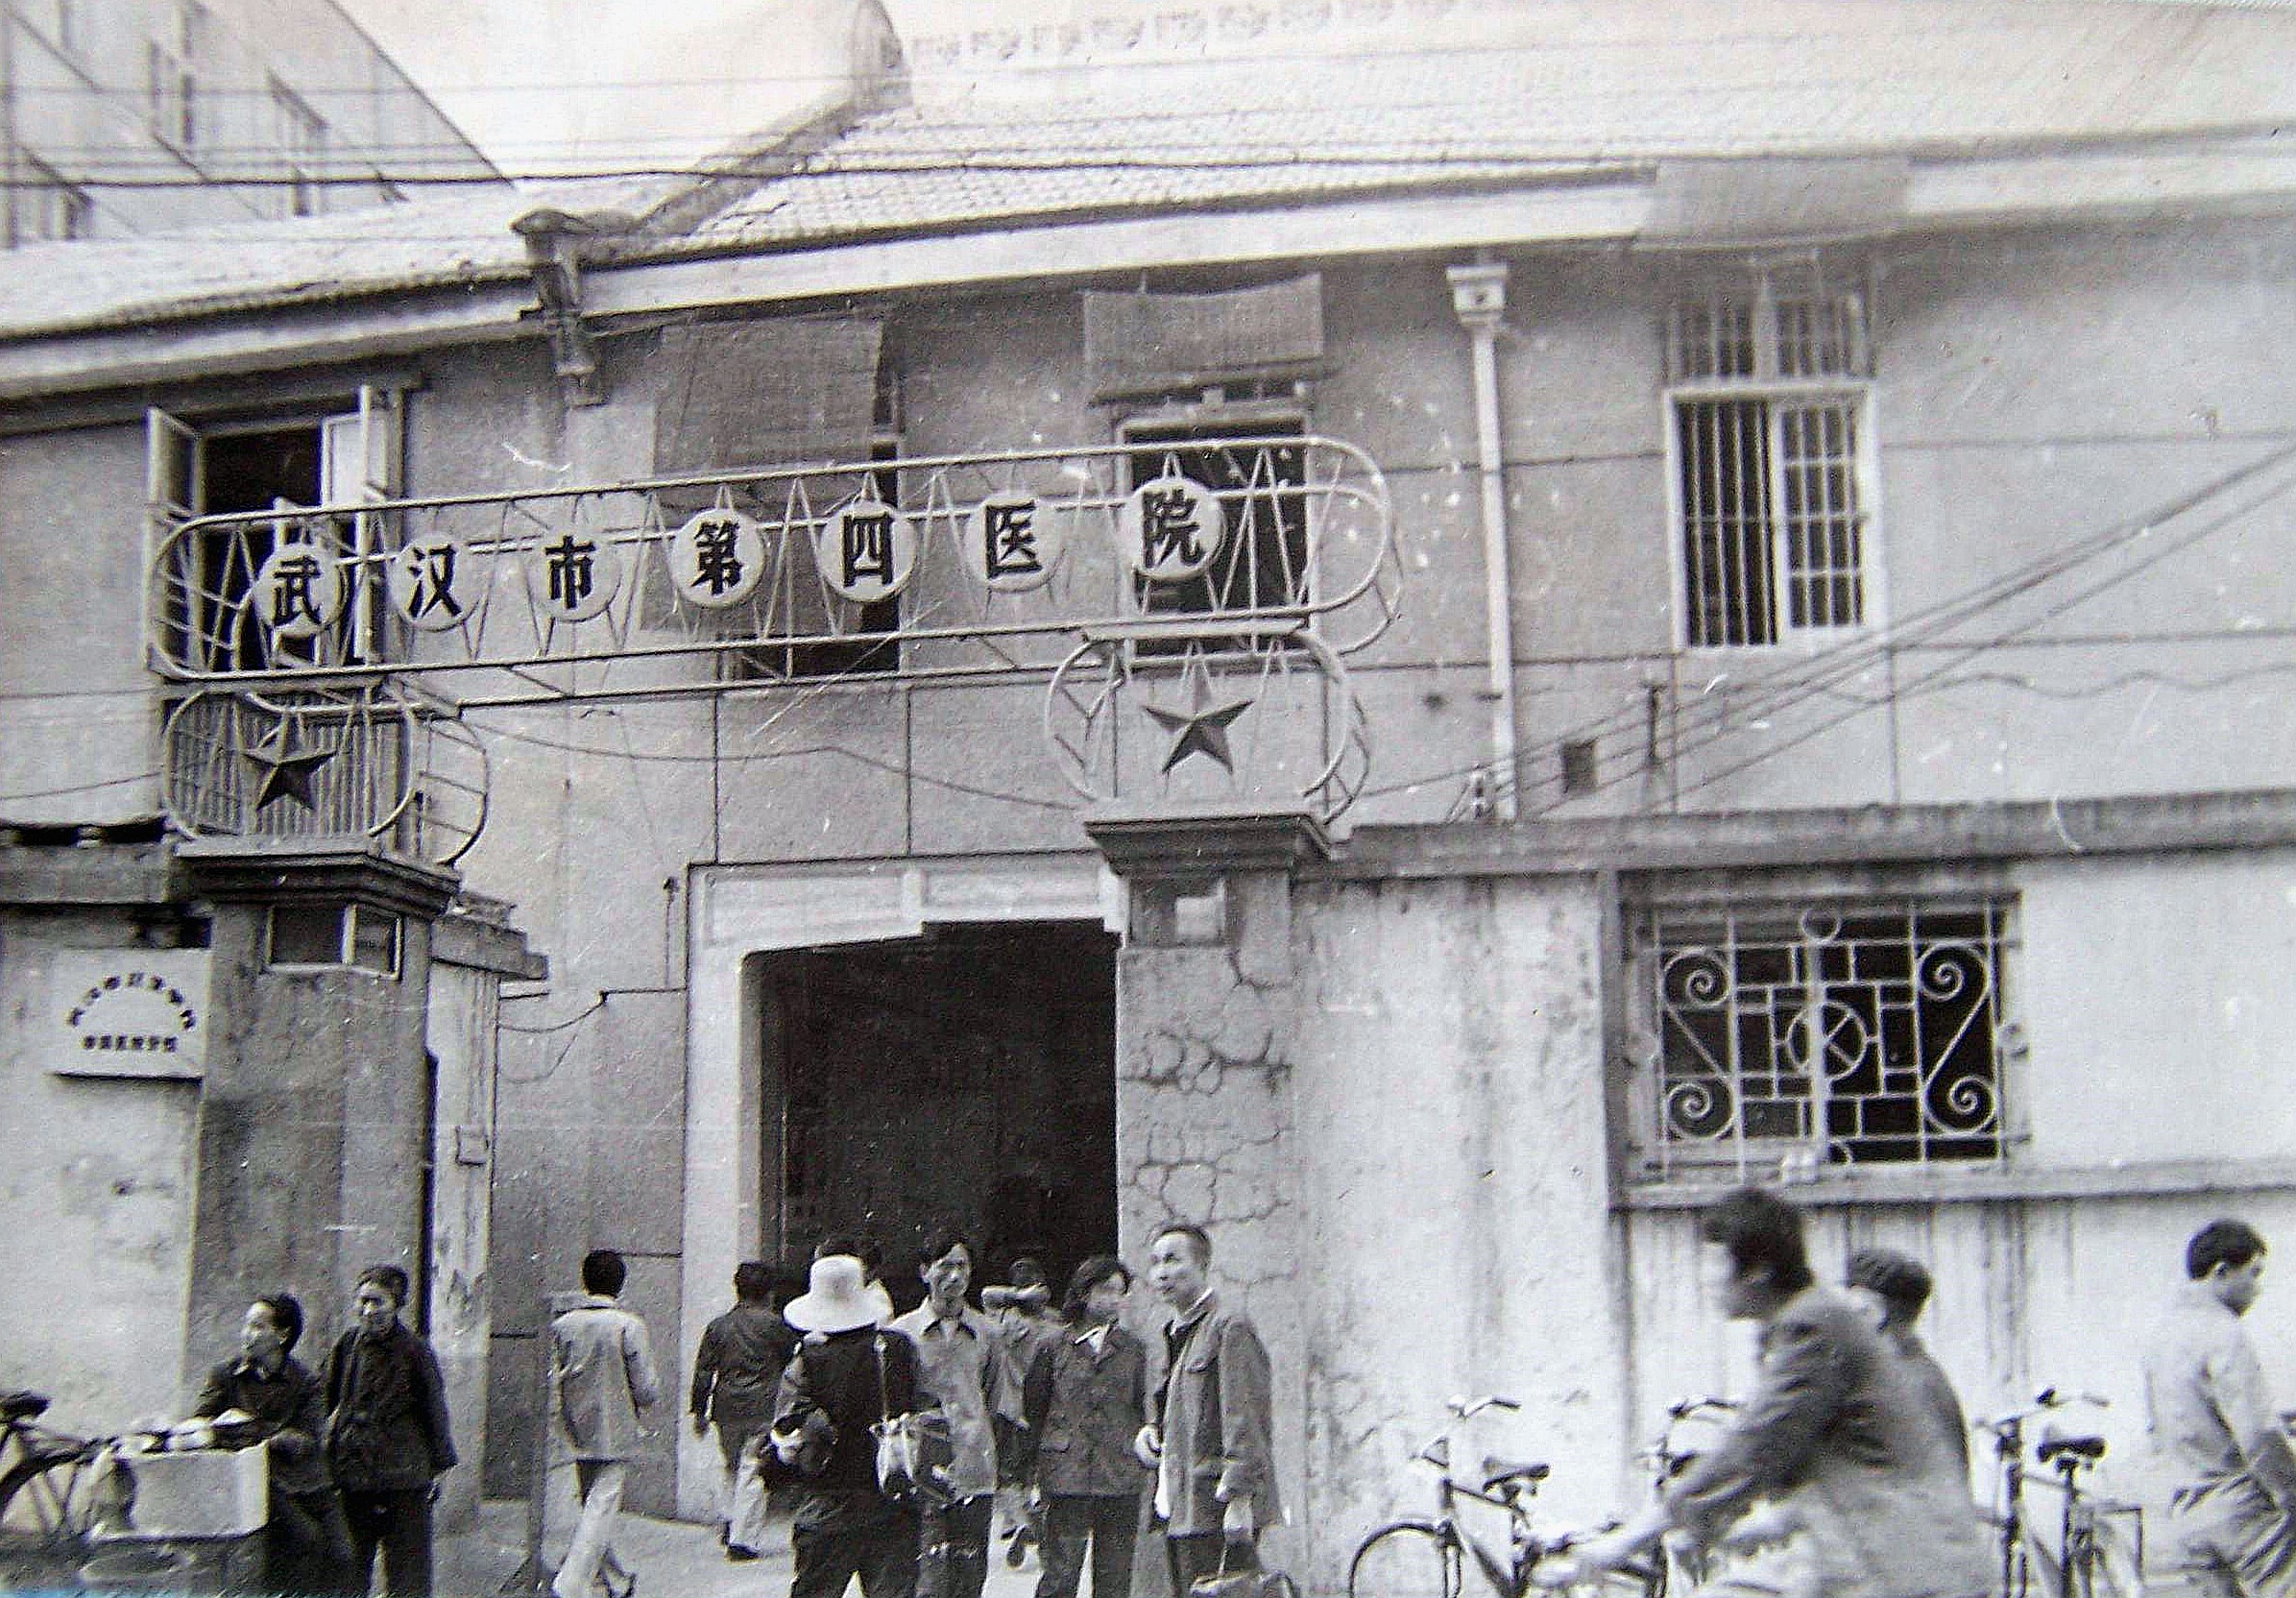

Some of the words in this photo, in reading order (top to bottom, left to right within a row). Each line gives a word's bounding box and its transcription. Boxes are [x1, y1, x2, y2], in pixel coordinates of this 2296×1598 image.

[273, 486, 1206, 628] 武汉市第四医院
